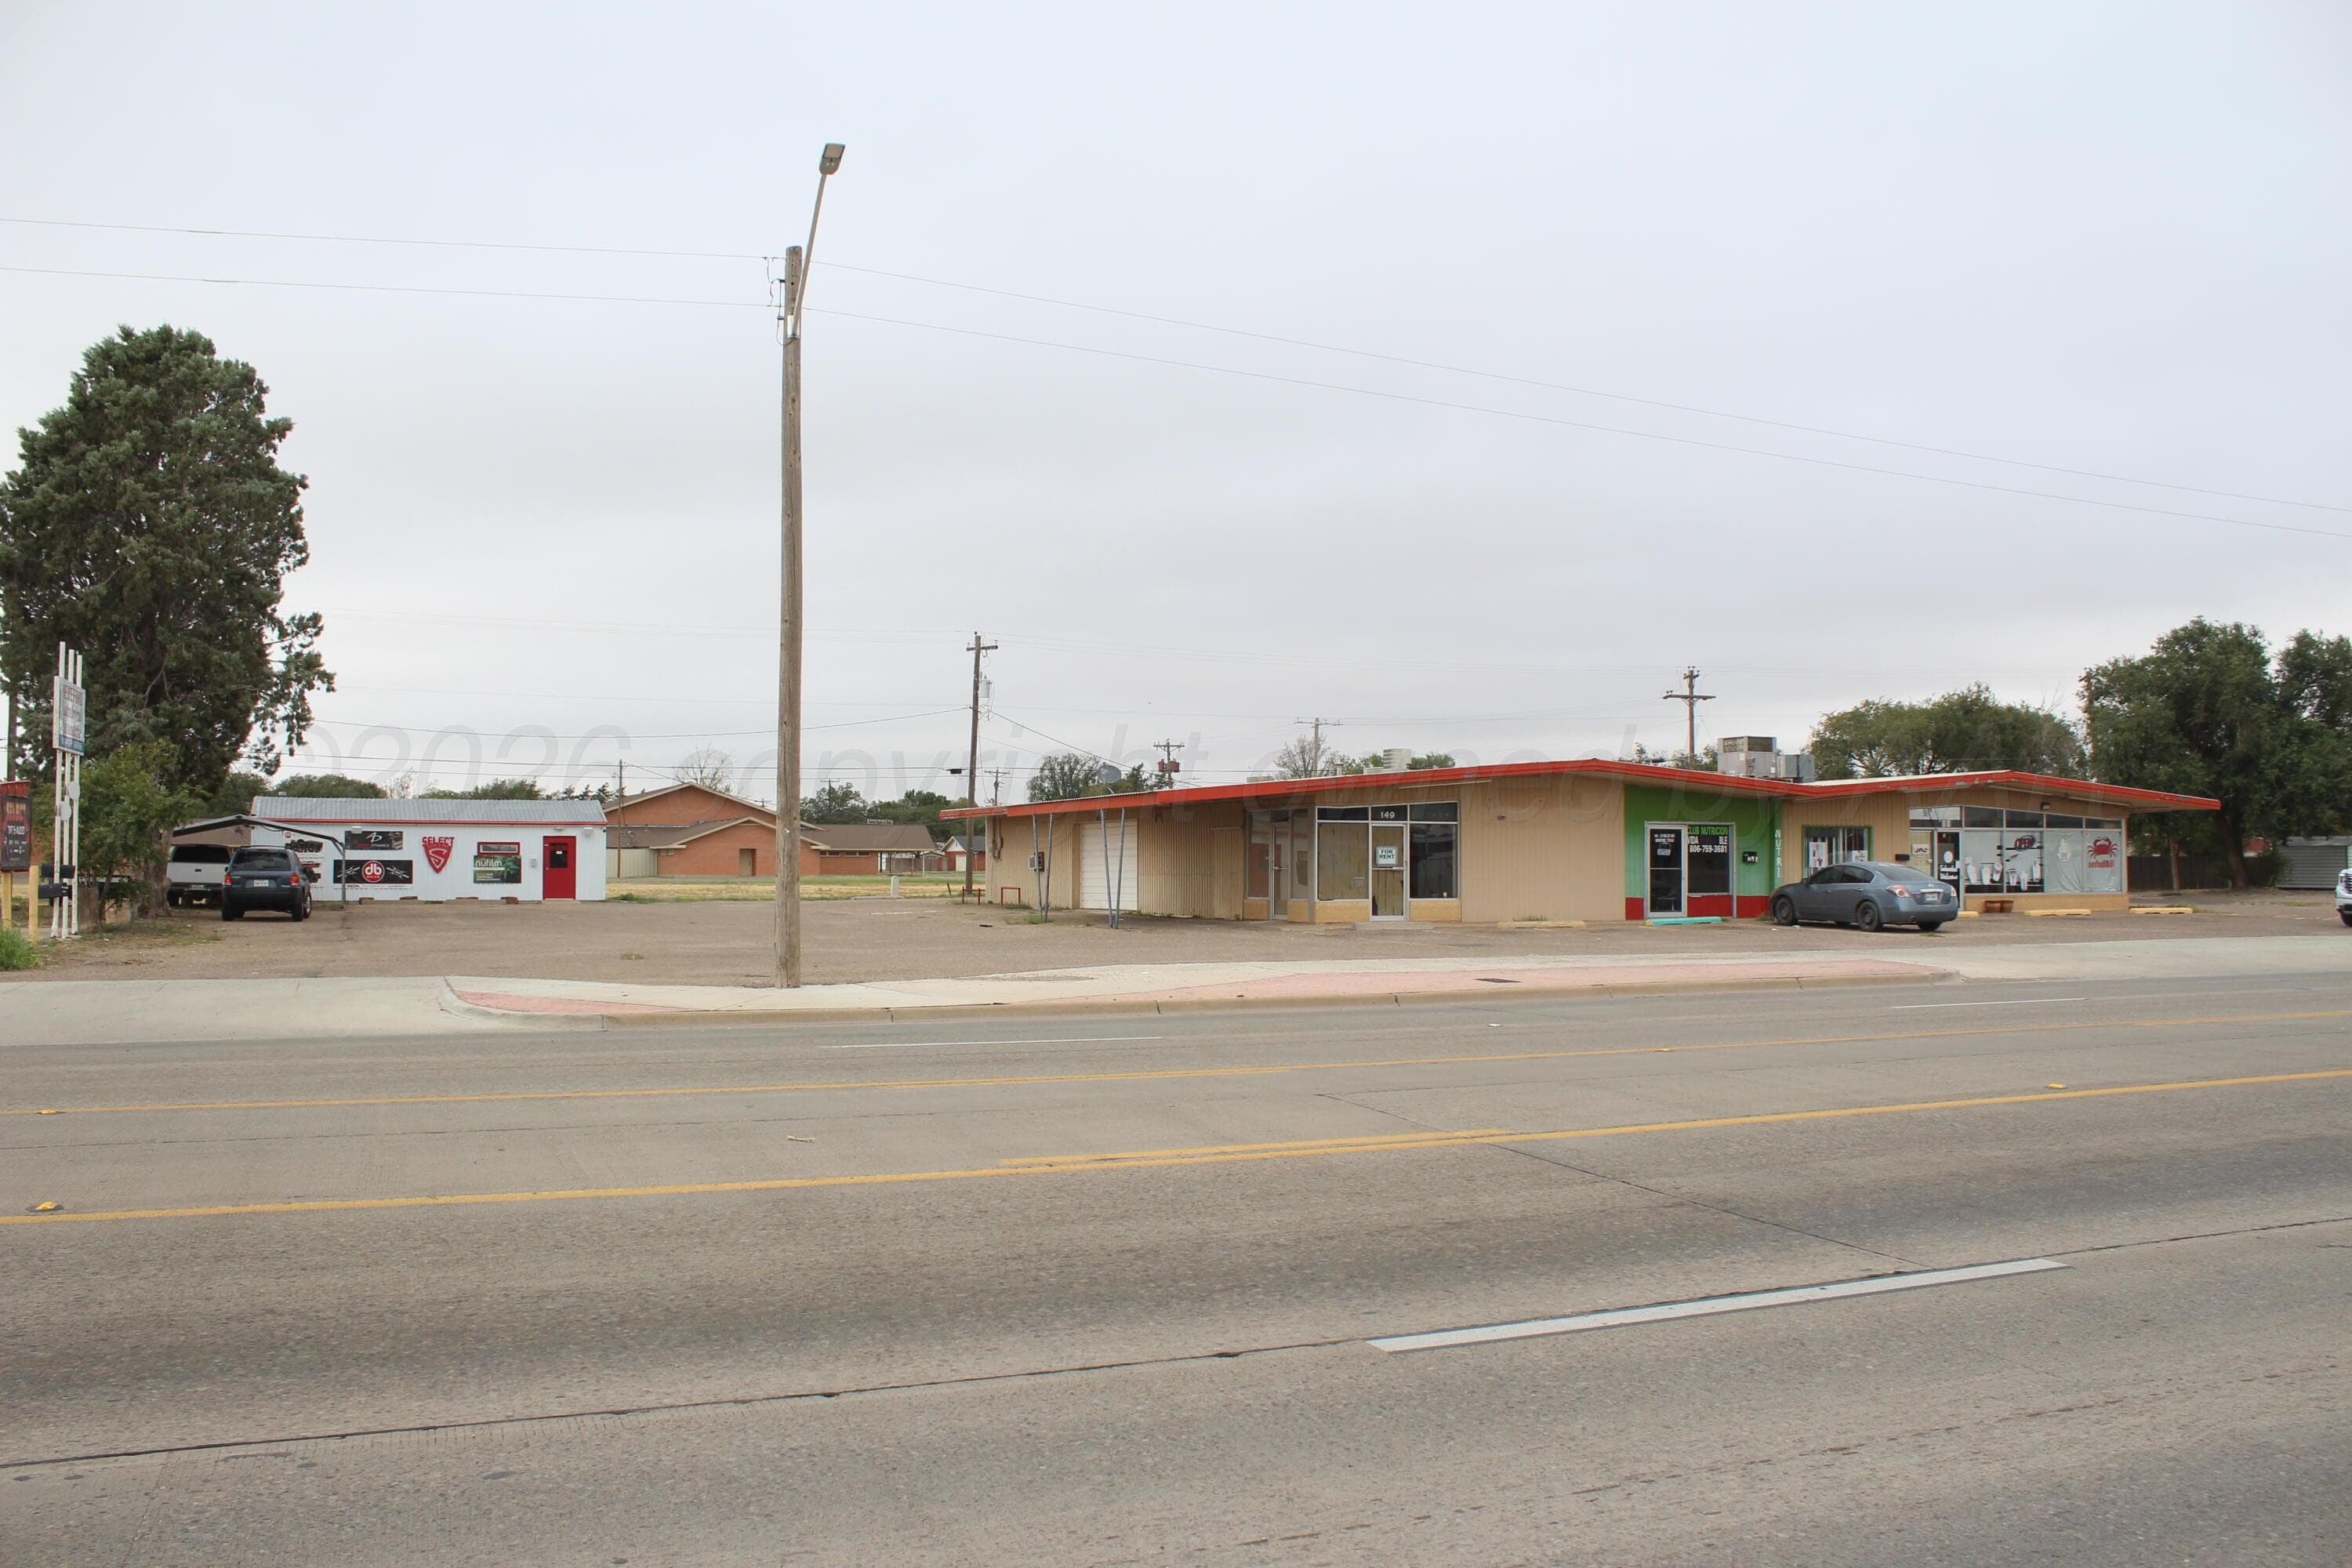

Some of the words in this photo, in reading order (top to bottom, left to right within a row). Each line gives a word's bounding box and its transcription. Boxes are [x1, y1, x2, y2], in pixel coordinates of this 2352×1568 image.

[1381, 811, 1396, 819] 149
[1700, 826, 1728, 835] NUTRICION
[422, 837, 455, 847] SELECT
[475, 858, 503, 867] nufilm
[365, 863, 382, 875] db
